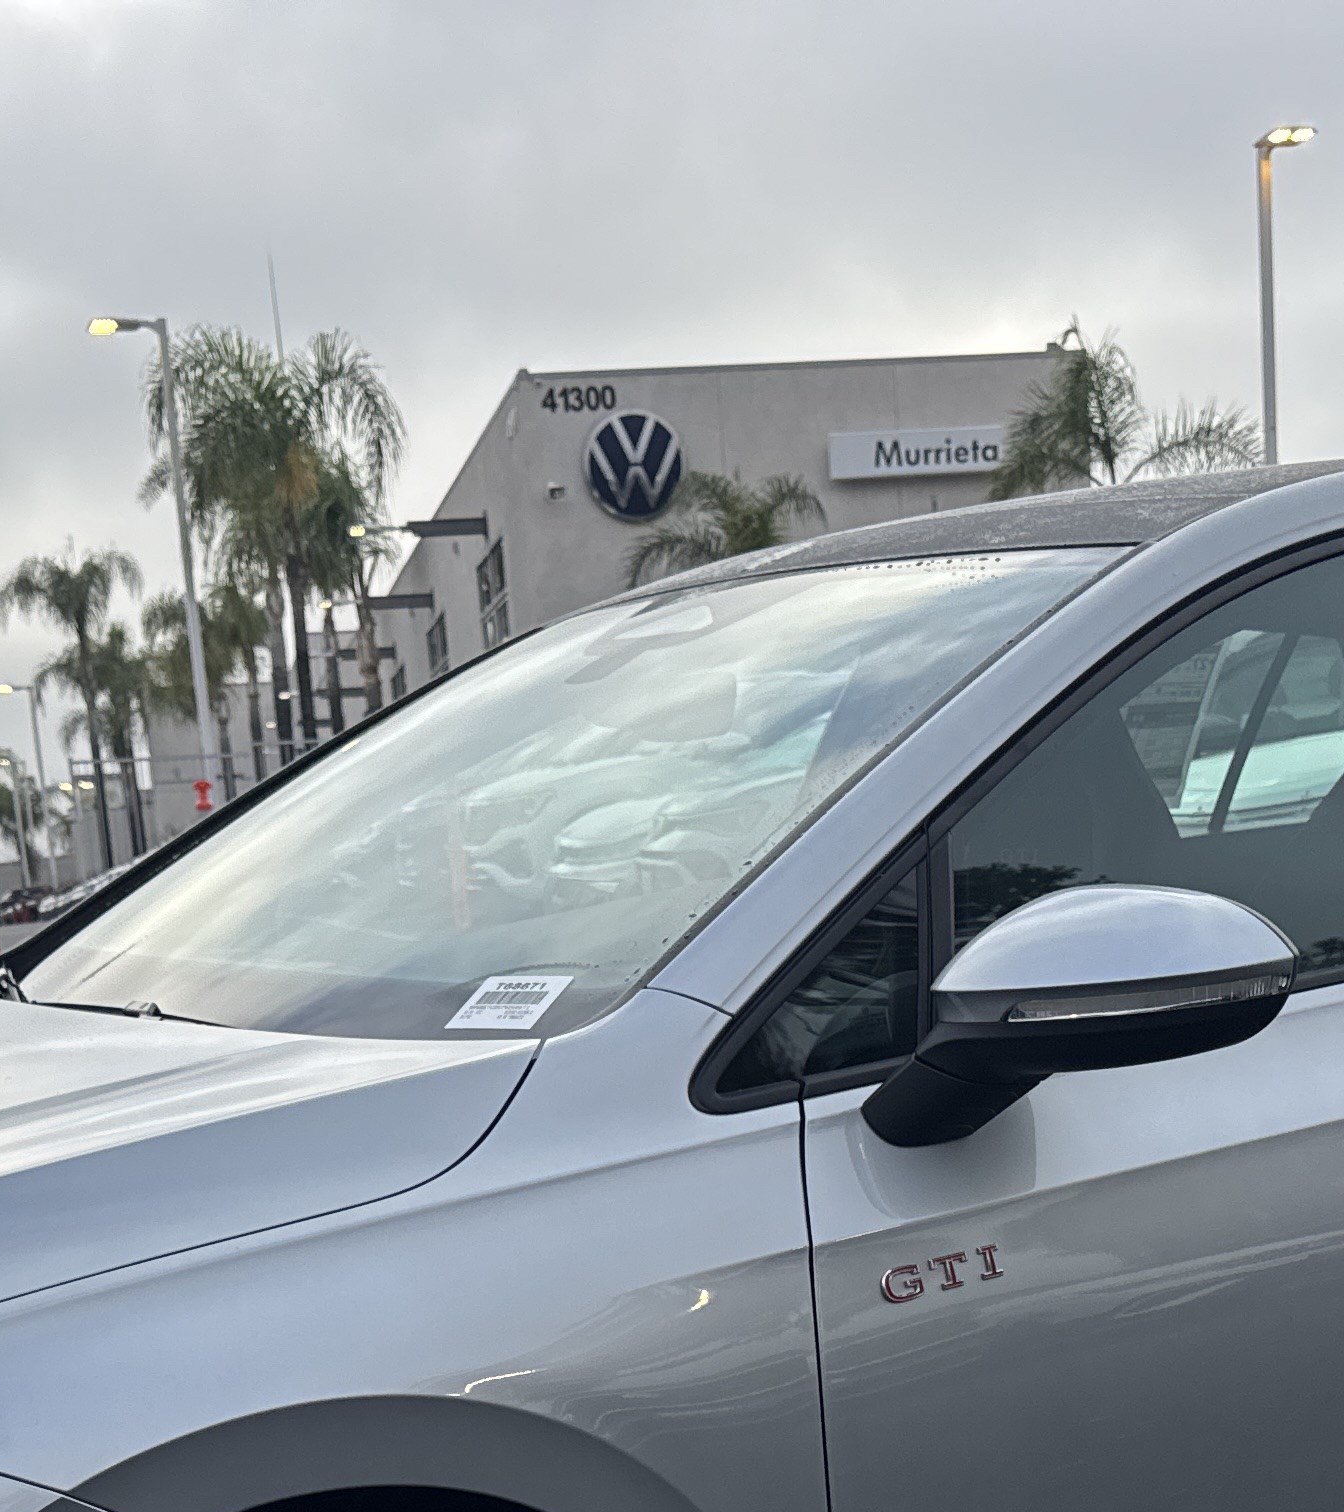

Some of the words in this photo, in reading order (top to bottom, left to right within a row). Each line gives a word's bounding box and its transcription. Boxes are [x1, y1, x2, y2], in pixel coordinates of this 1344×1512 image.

[541, 385, 616, 412] 41300
[586, 411, 681, 512] VW
[874, 437, 999, 468] Murrieta
[880, 1242, 1004, 1303] GTI
